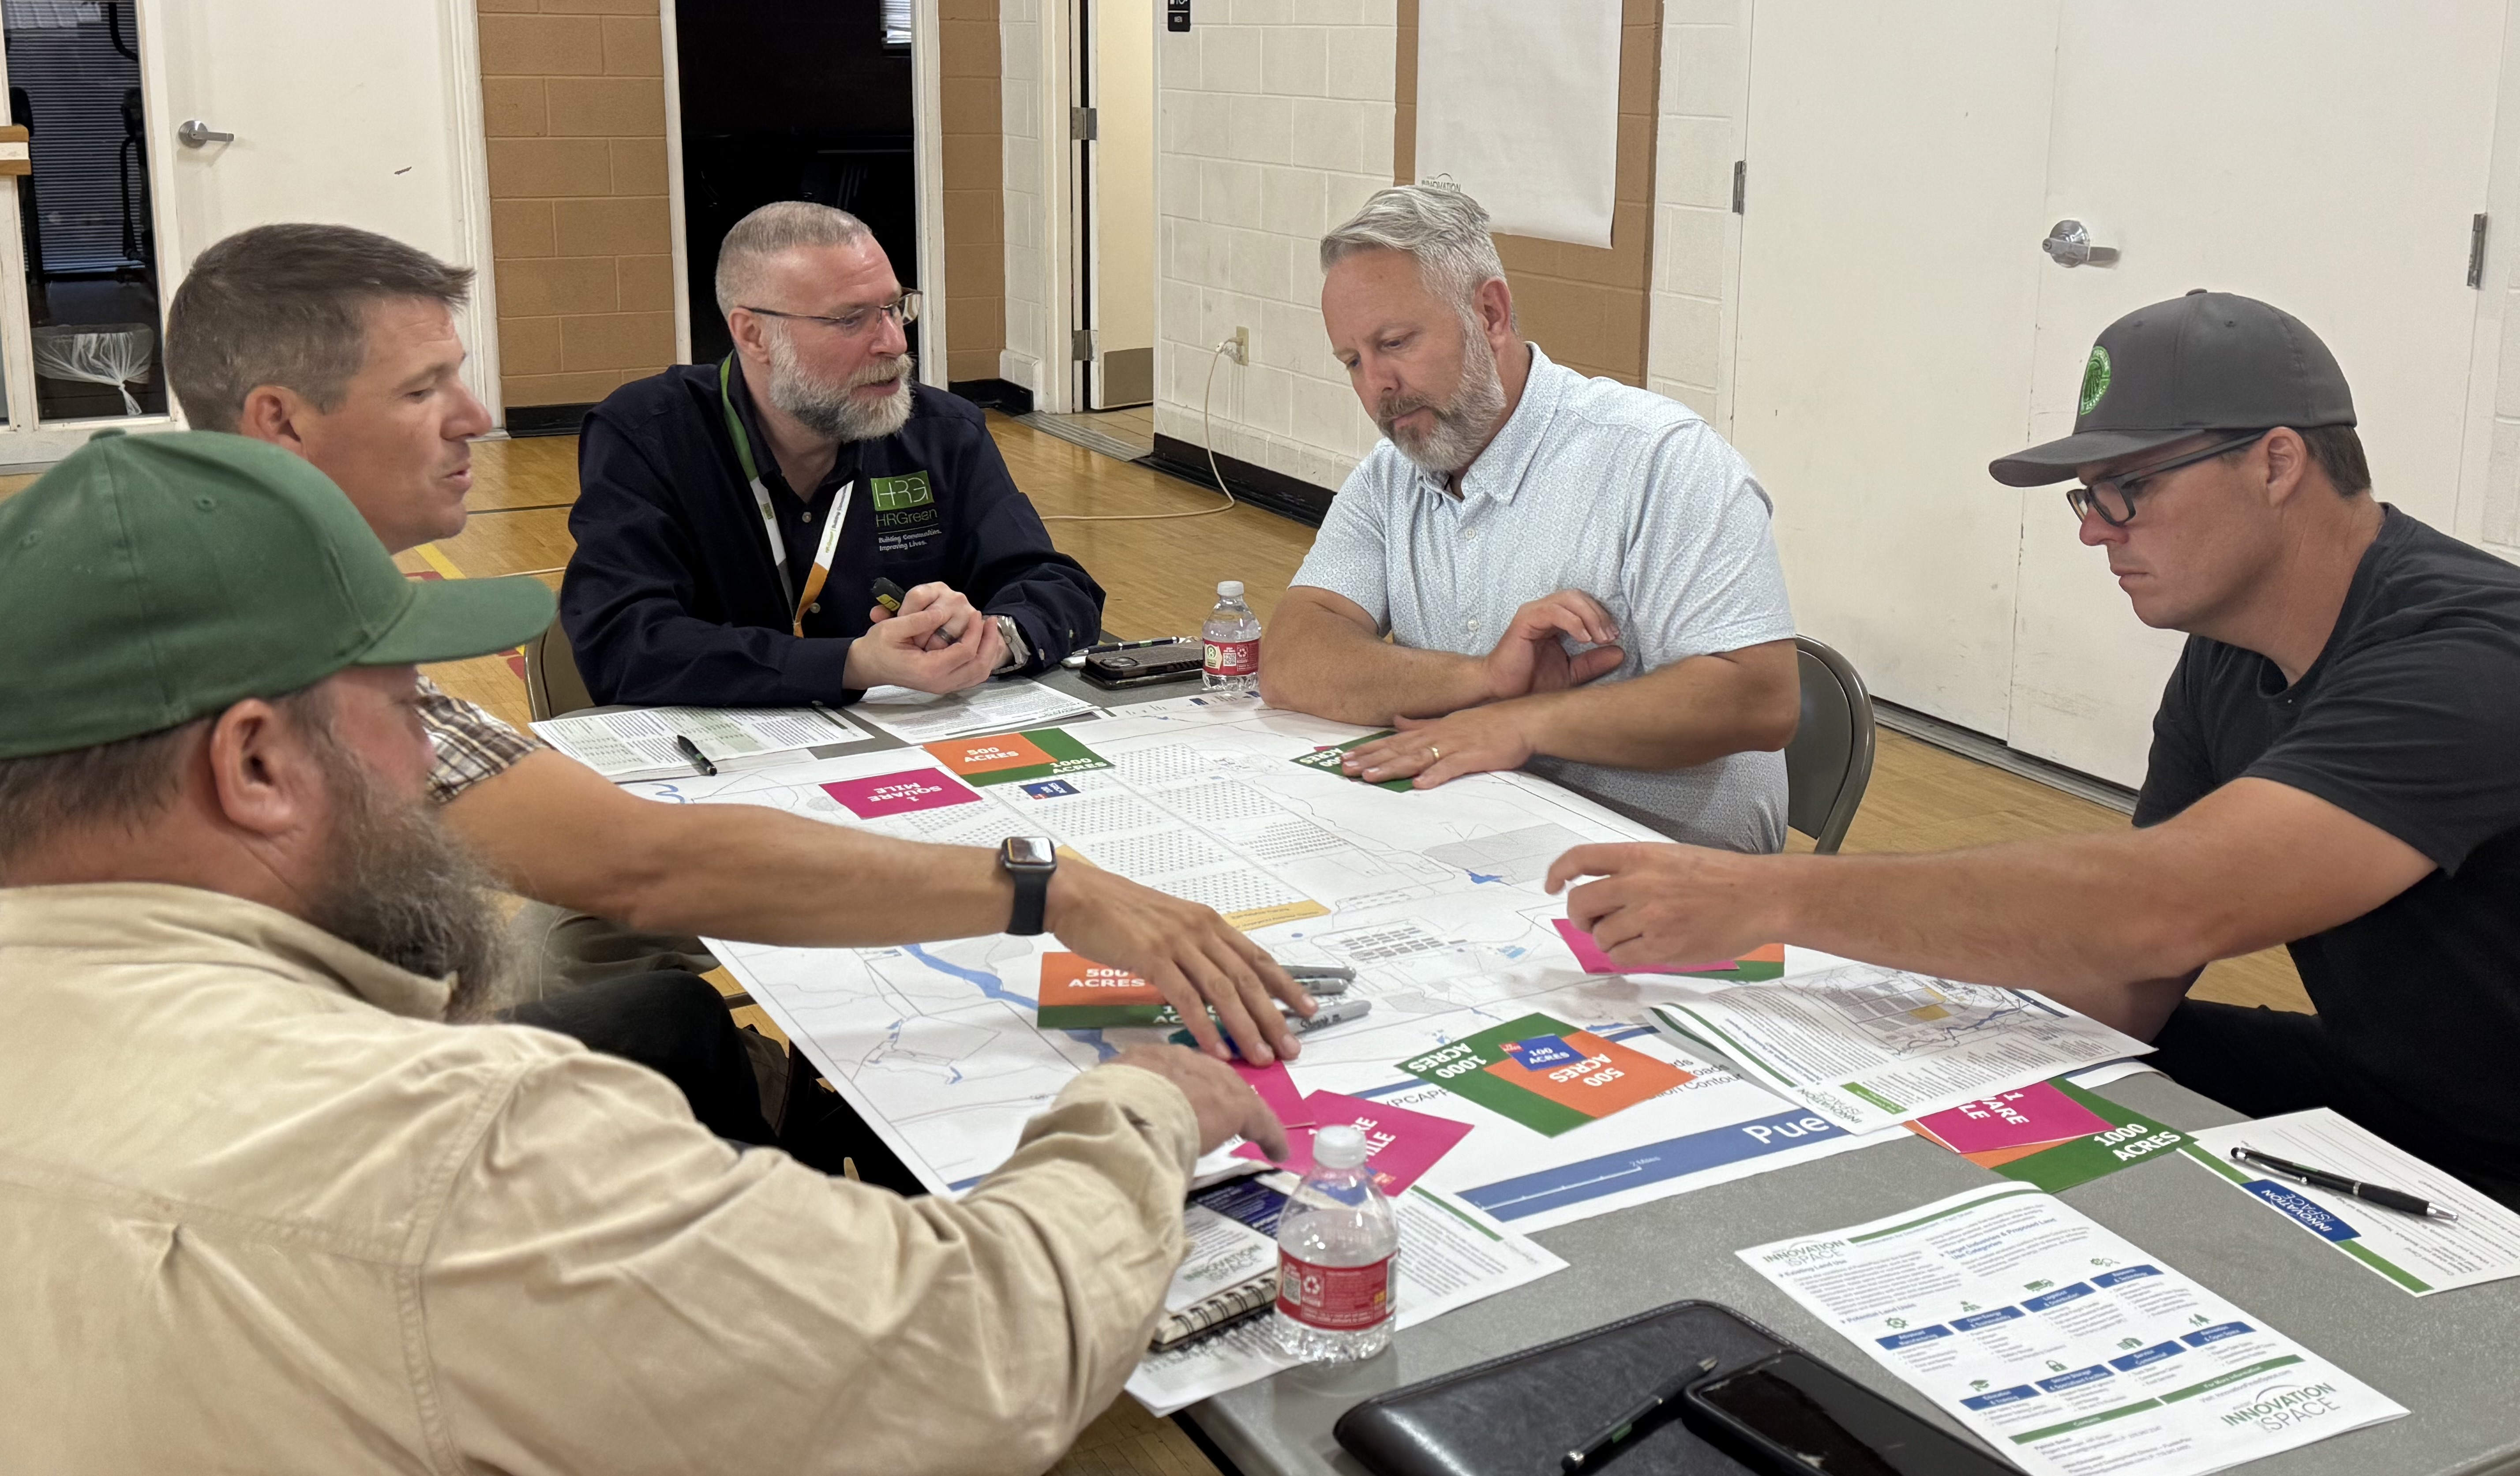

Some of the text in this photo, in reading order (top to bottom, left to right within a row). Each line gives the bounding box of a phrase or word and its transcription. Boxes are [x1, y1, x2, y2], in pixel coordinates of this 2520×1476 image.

[876, 509, 938, 527] HRGreen
[964, 751, 1020, 762] ACRES
[967, 747, 1000, 756] 500
[1050, 758, 1092, 768] 1000
[1053, 762, 1108, 774] ACRES
[867, 786, 943, 803] SQUARE
[873, 783, 921, 794] MILE
[1068, 978, 1145, 988] ACRES
[1408, 1043, 1473, 1072] ACRES
[1528, 1047, 1553, 1058] 100
[1529, 1051, 1570, 1065] ACRES
[1436, 1055, 1487, 1079] 1000
[1549, 1053, 1612, 1083] ACRES
[1692, 1064, 1730, 1076] oads
[1583, 1068, 1625, 1086] 500
[2003, 1092, 2024, 1101] 1
[1798, 1088, 1863, 1124] INNOVATION
[1958, 1104, 1991, 1119] LE
[2093, 1124, 2148, 1146] 1000
[2112, 1131, 2181, 1161] ACRES
[2261, 1189, 2332, 1232] INNOVATION
[2286, 1193, 2331, 1220] SPACE
[1762, 1239, 1845, 1263] INNOVATION
[1788, 1249, 1845, 1266] SPACE
[2220, 1382, 2337, 1426] INNOVATION
[2261, 1397, 2341, 1431] SPACE
